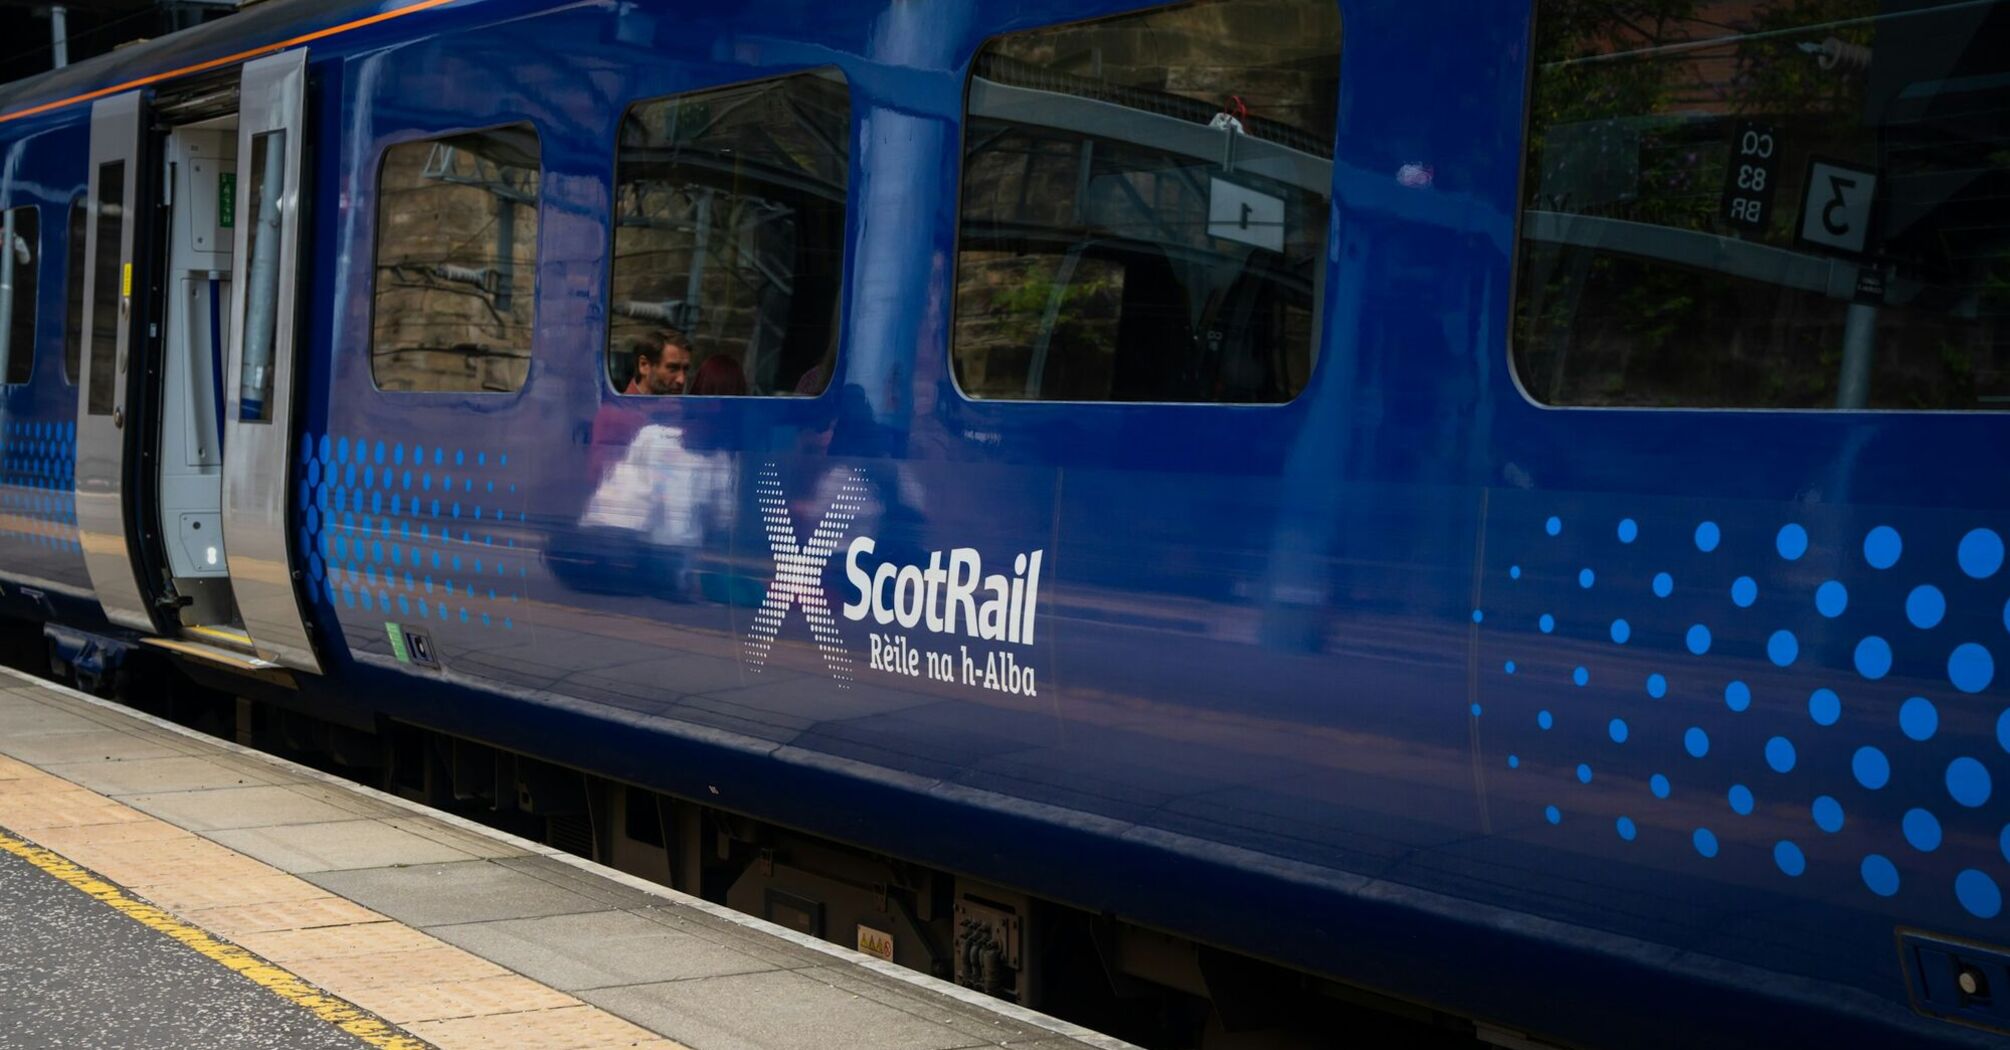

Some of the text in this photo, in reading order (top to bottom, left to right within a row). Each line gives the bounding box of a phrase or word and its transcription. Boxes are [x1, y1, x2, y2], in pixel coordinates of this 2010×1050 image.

[843, 536, 1043, 645] ScotRail
[869, 633, 1037, 697] Rèile na h-Alba
